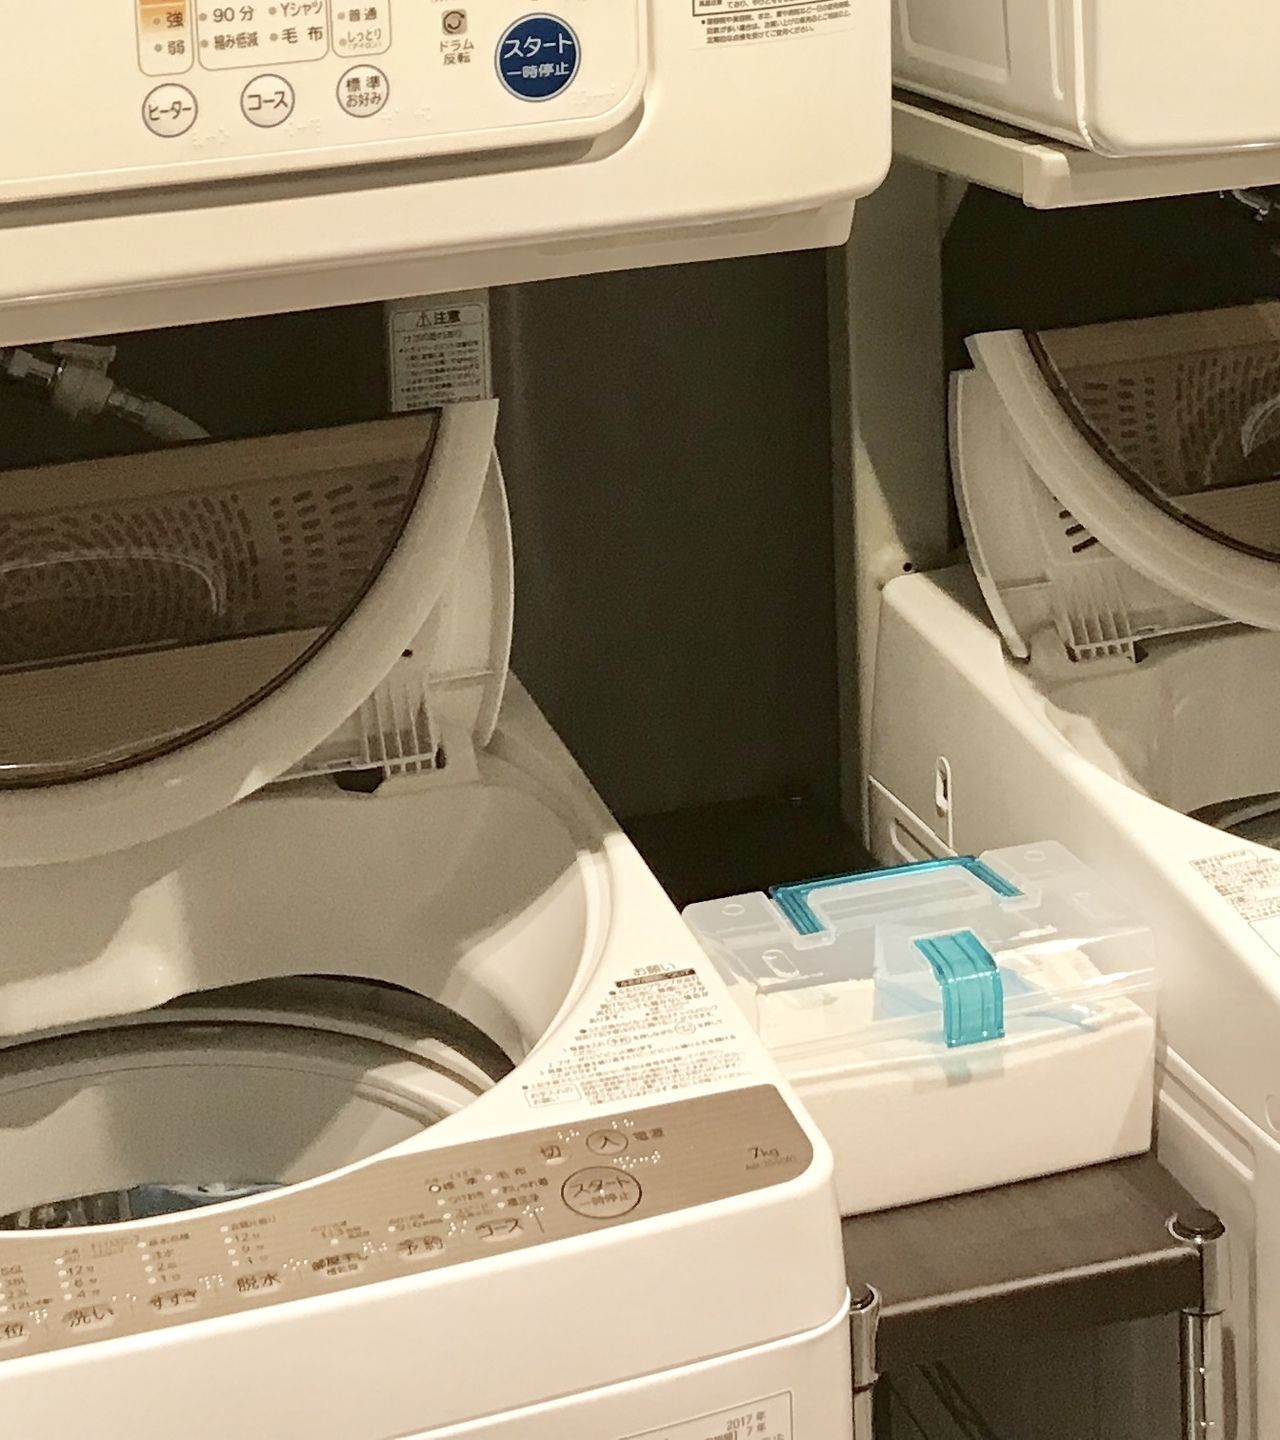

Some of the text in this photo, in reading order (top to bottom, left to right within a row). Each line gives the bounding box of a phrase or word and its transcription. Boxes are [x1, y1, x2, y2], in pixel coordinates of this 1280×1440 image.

[280, 0, 324, 18] Yシャツ
[166, 11, 185, 29] 強
[281, 25, 324, 44] 毛布
[439, 38, 476, 53] ドラム
[503, 32, 574, 60] スタート
[442, 52, 472, 67] 反転
[506, 60, 571, 80] 一時停止
[246, 90, 289, 112] コース
[345, 91, 383, 109] お好み
[147, 101, 193, 123] ヒーター
[748, 1145, 781, 1161] 7kg
[569, 1176, 632, 1198] スタート
